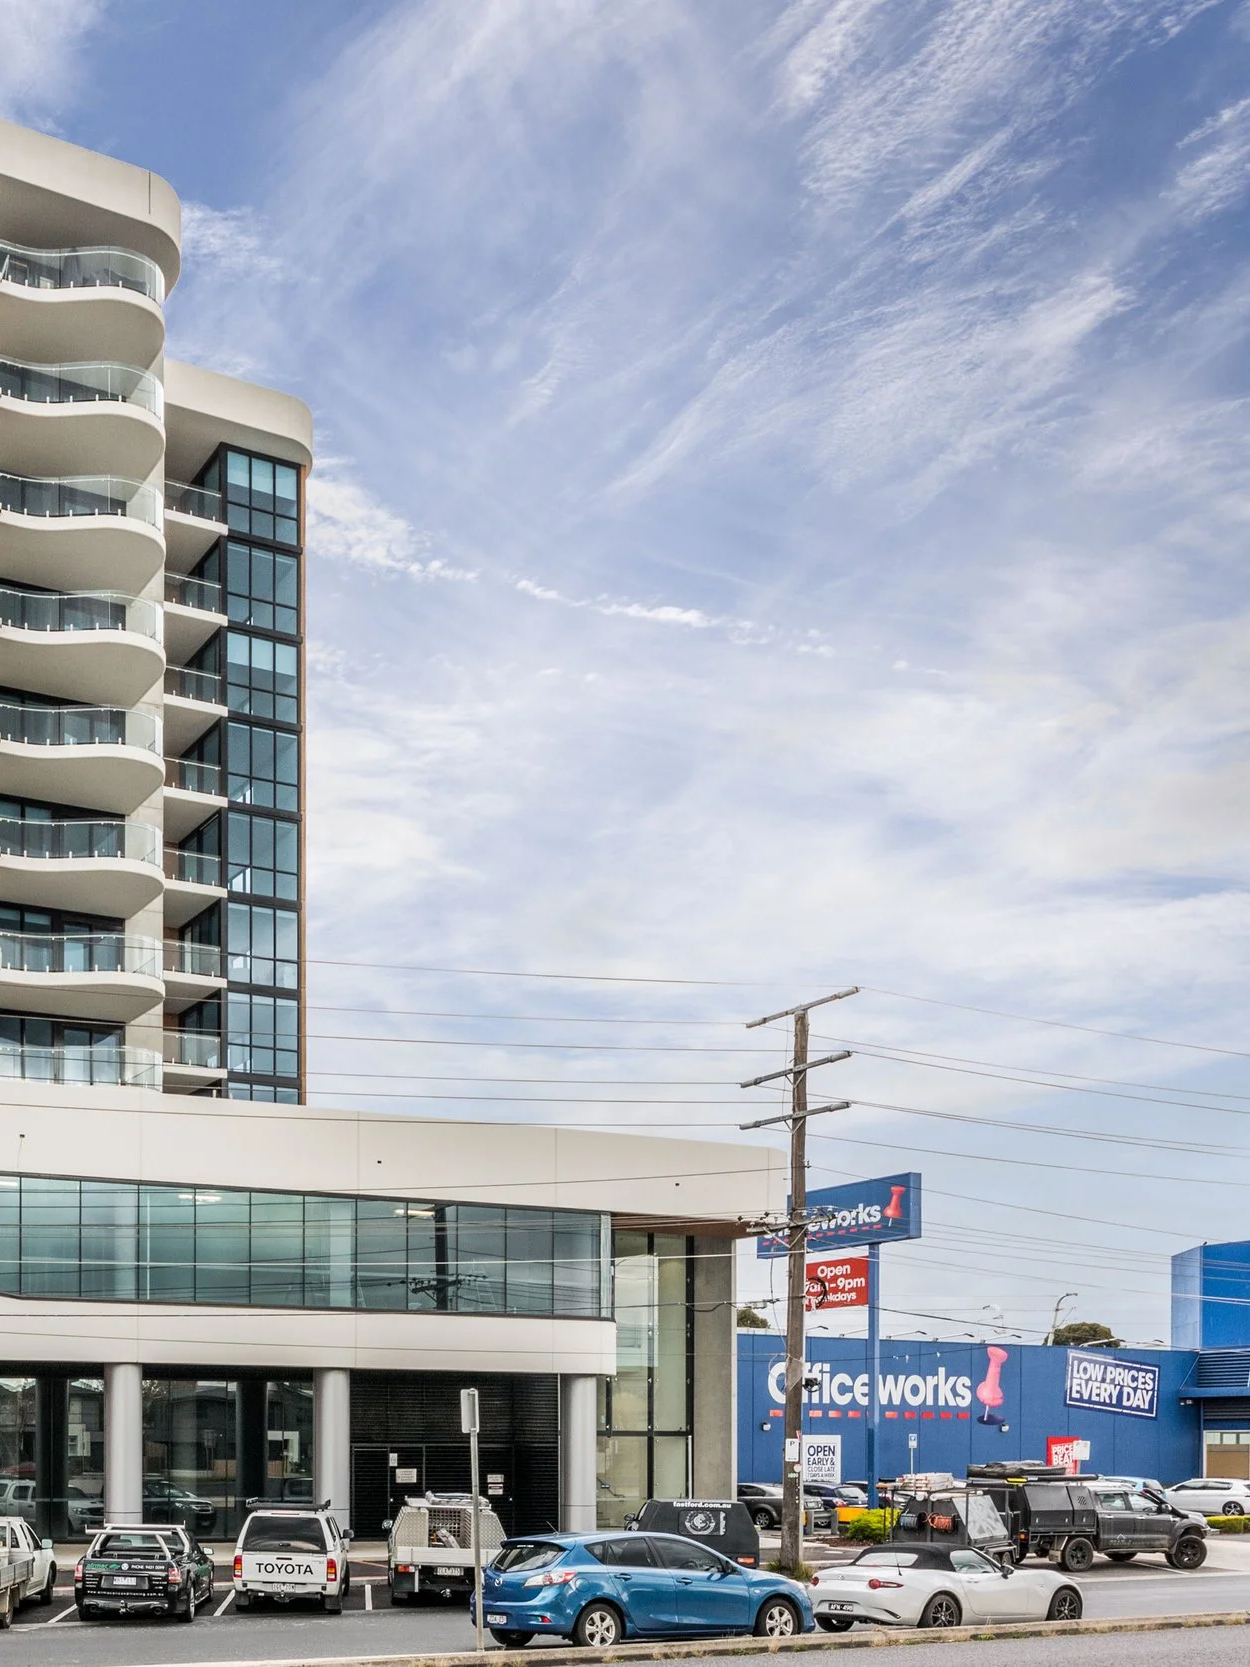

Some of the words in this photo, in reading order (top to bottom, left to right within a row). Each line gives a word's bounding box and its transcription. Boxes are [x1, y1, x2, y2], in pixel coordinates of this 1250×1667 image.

[817, 1264, 851, 1279] Open
[1073, 1360, 1105, 1382] LOW
[1106, 1365, 1154, 1391] PRICES
[1071, 1378, 1120, 1404] EVERY
[1122, 1386, 1153, 1410] DAY
[807, 1445, 836, 1457] OPEN
[807, 1457, 829, 1466] EARLY
[830, 1457, 835, 1466] &
[672, 1501, 732, 1509] fastford.com.au
[255, 1562, 314, 1575] TOYOTA
